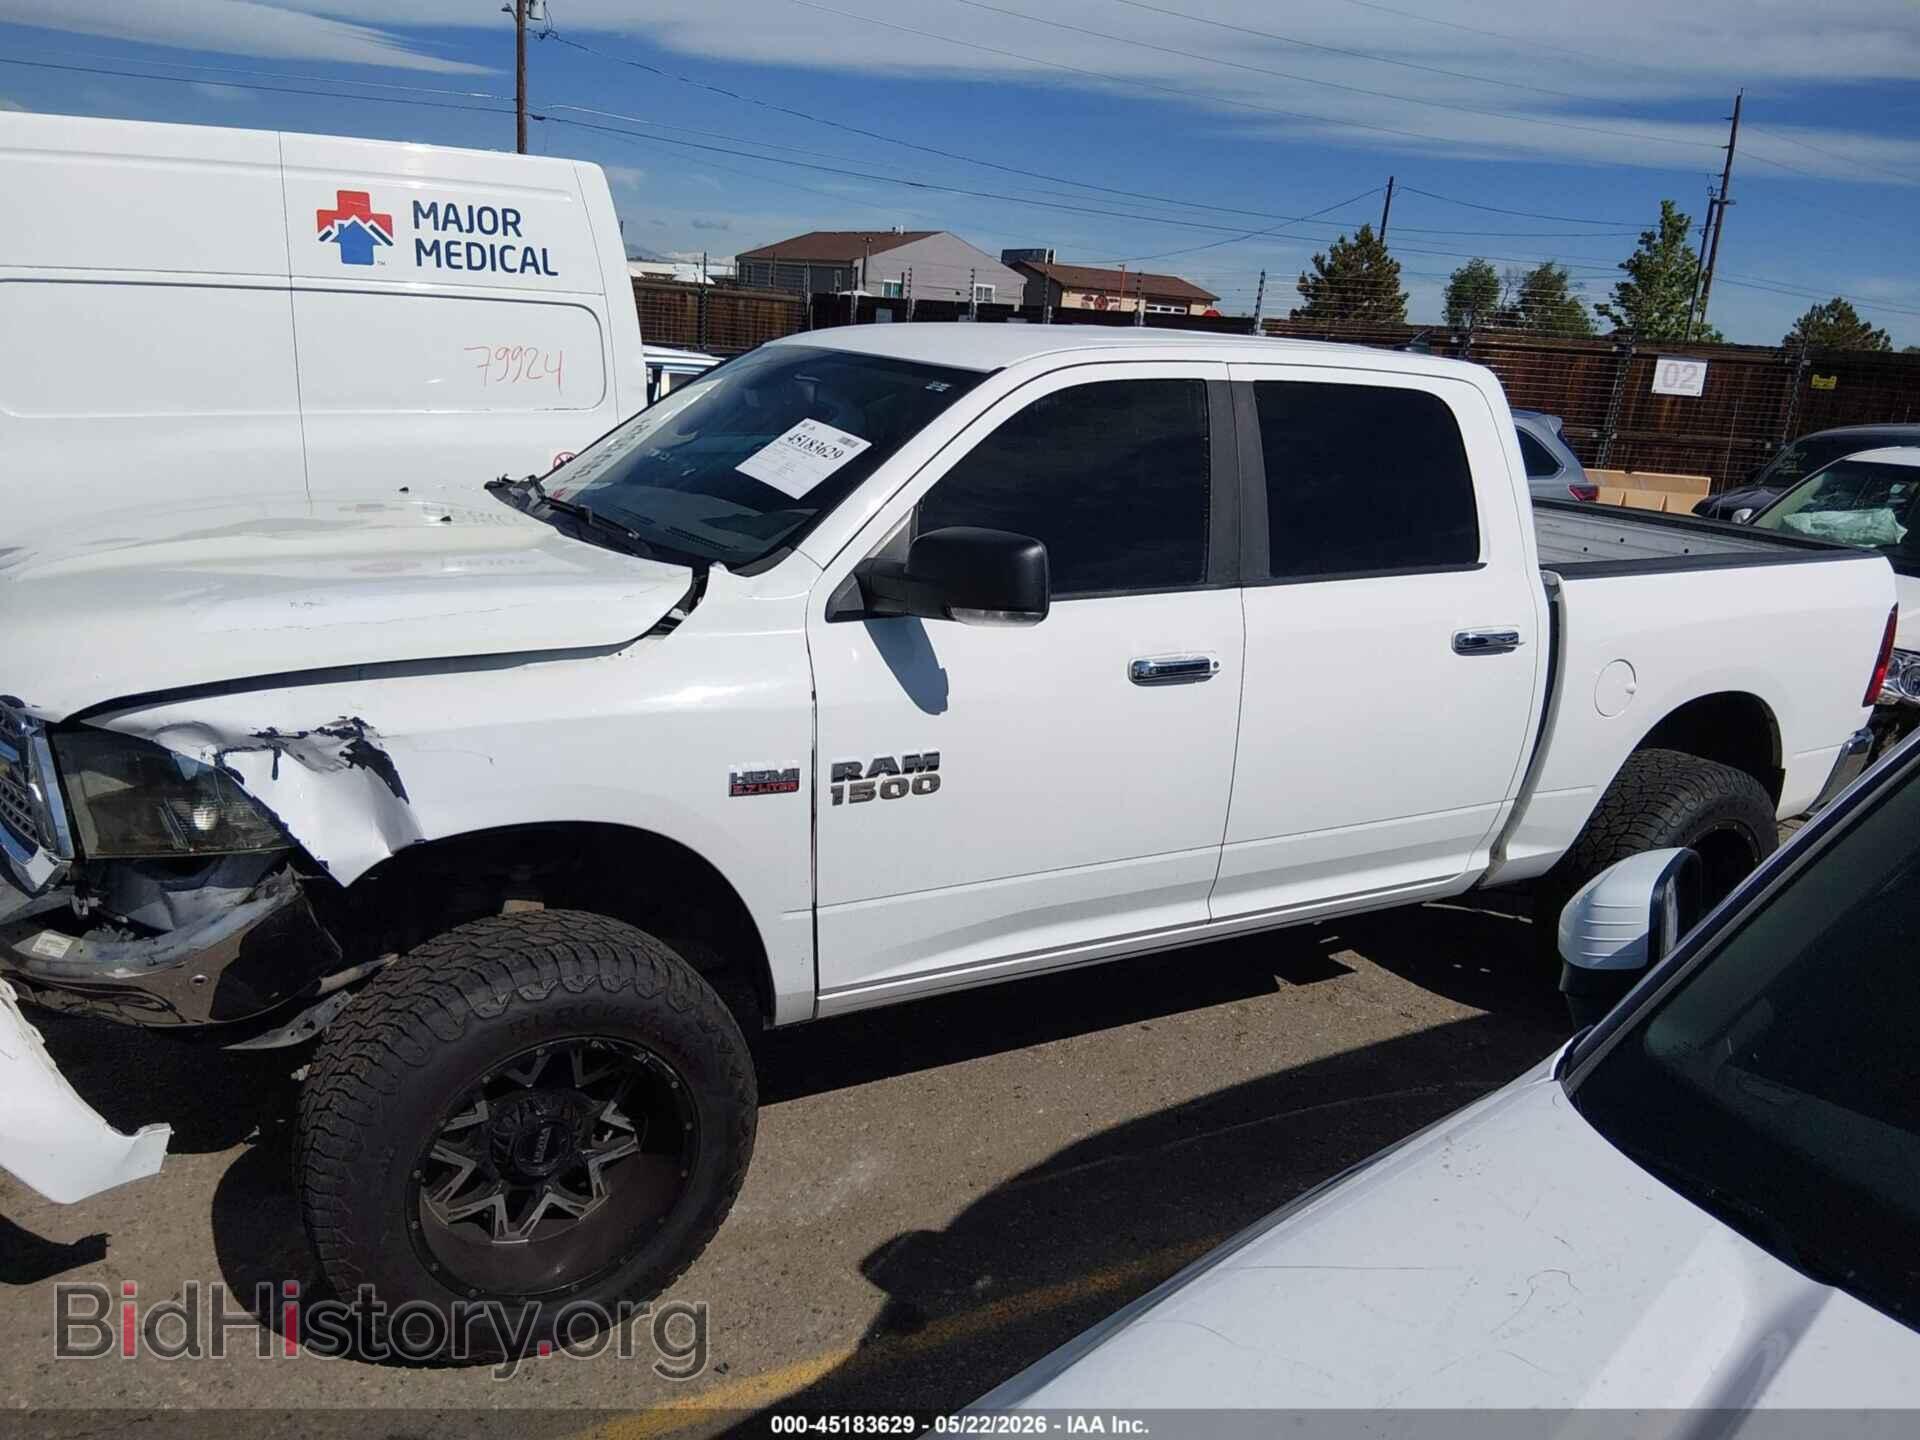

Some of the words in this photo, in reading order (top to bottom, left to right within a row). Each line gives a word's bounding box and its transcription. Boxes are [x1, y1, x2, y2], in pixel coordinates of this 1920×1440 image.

[412, 200, 522, 238] MAJOR
[414, 238, 559, 276] MEDICAL
[464, 345, 563, 395] 79924
[1663, 362, 1698, 389] 02
[787, 432, 845, 461] 45183629
[729, 768, 800, 785] HEMI
[830, 751, 941, 783] RAM
[830, 773, 942, 806] 1500
